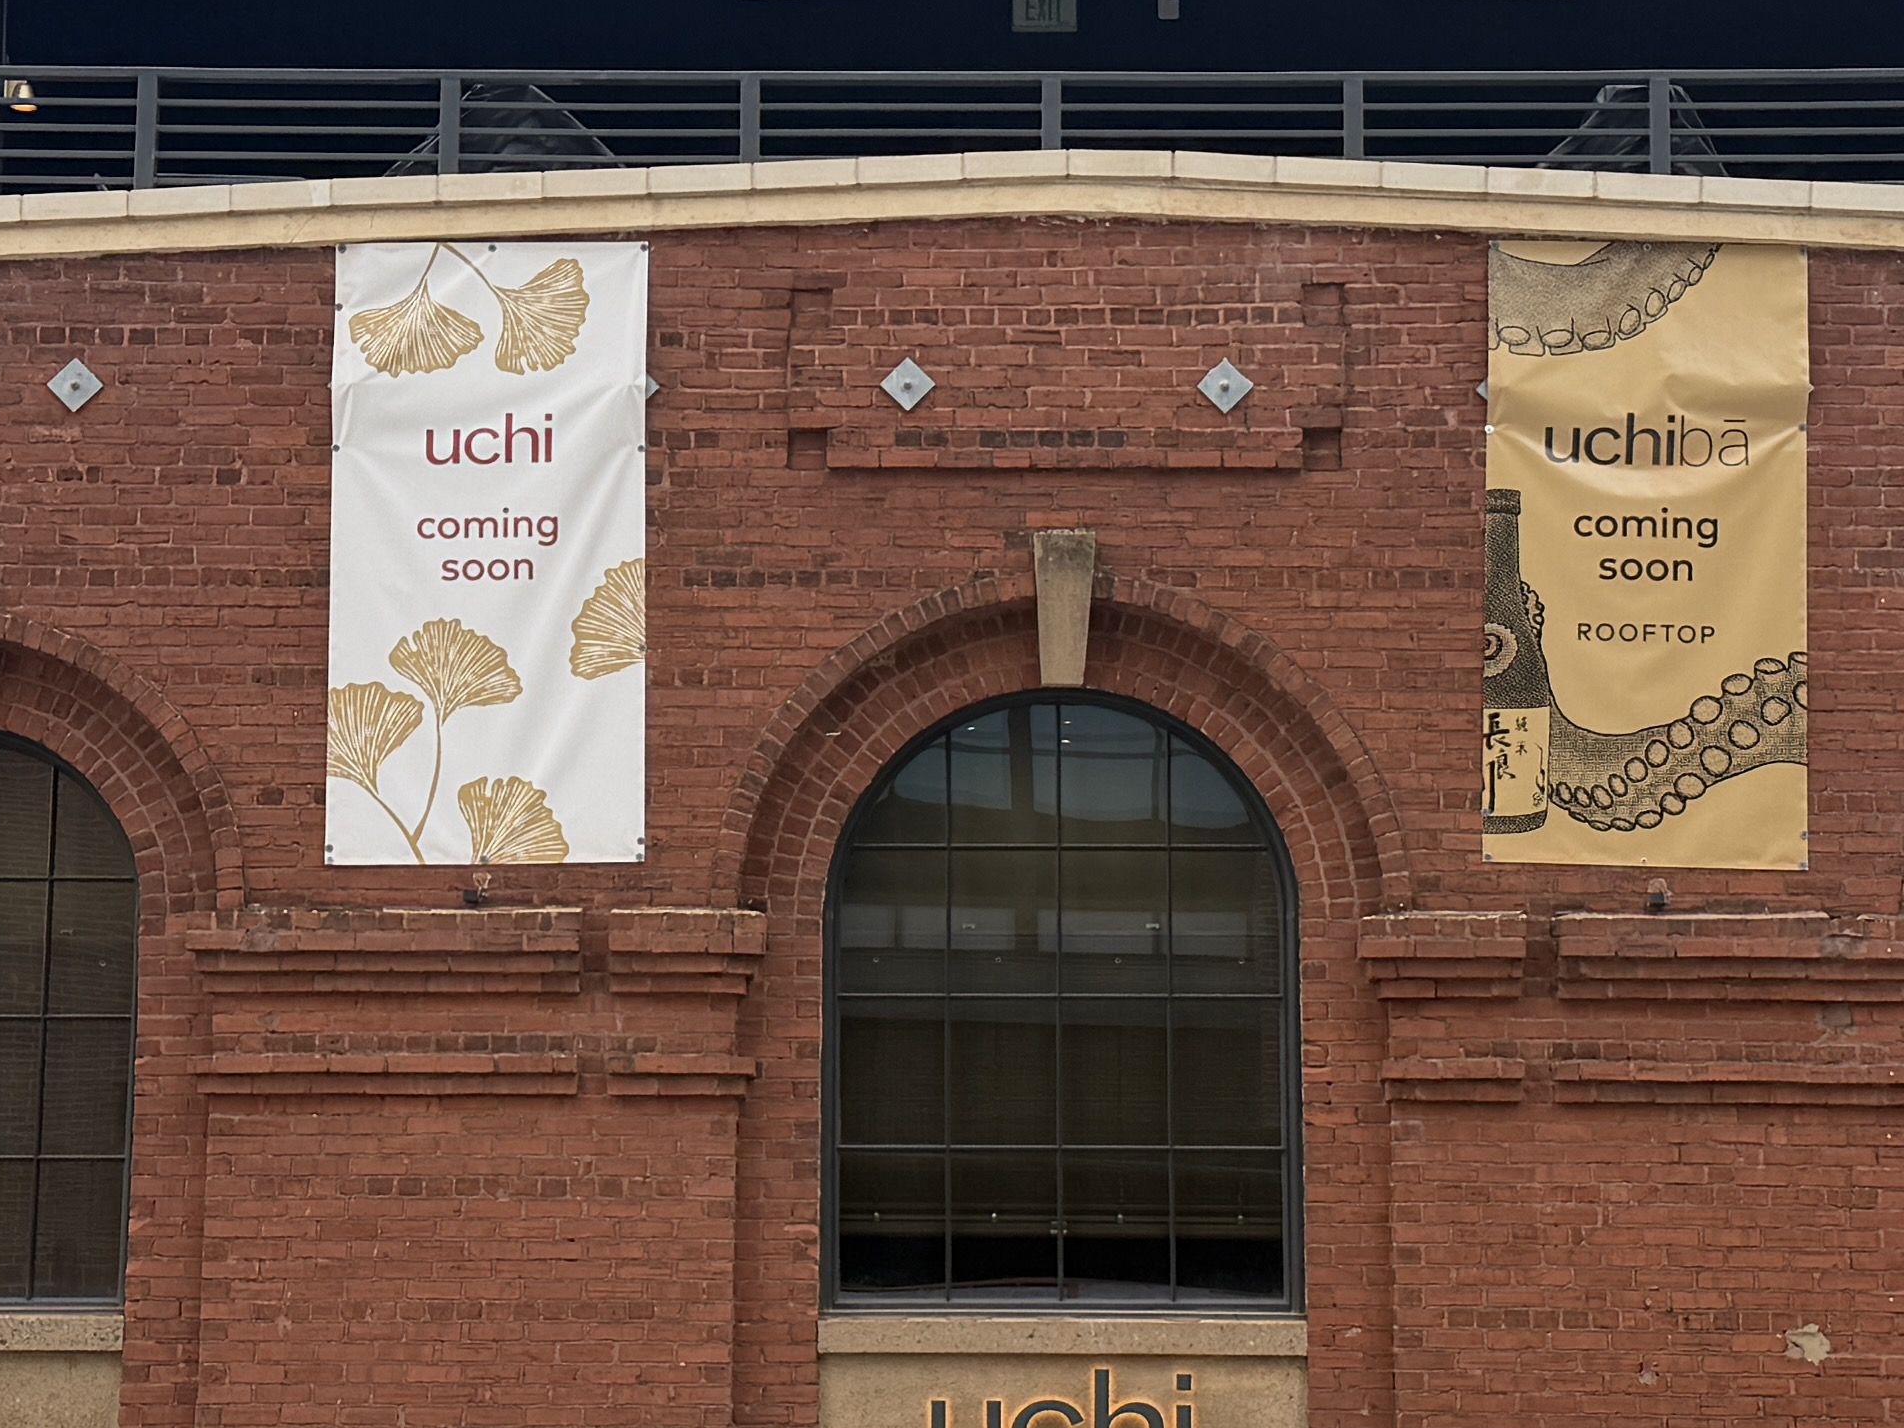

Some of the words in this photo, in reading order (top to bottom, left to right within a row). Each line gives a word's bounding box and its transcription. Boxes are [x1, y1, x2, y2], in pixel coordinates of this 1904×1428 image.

[424, 412, 553, 465] uchi
[1544, 413, 1750, 467] uchibā
[416, 508, 559, 547] coming
[1573, 507, 1719, 548] coming
[441, 556, 534, 582] soon
[1598, 556, 1694, 583] soon
[1576, 622, 1716, 645] ROOFTOP
